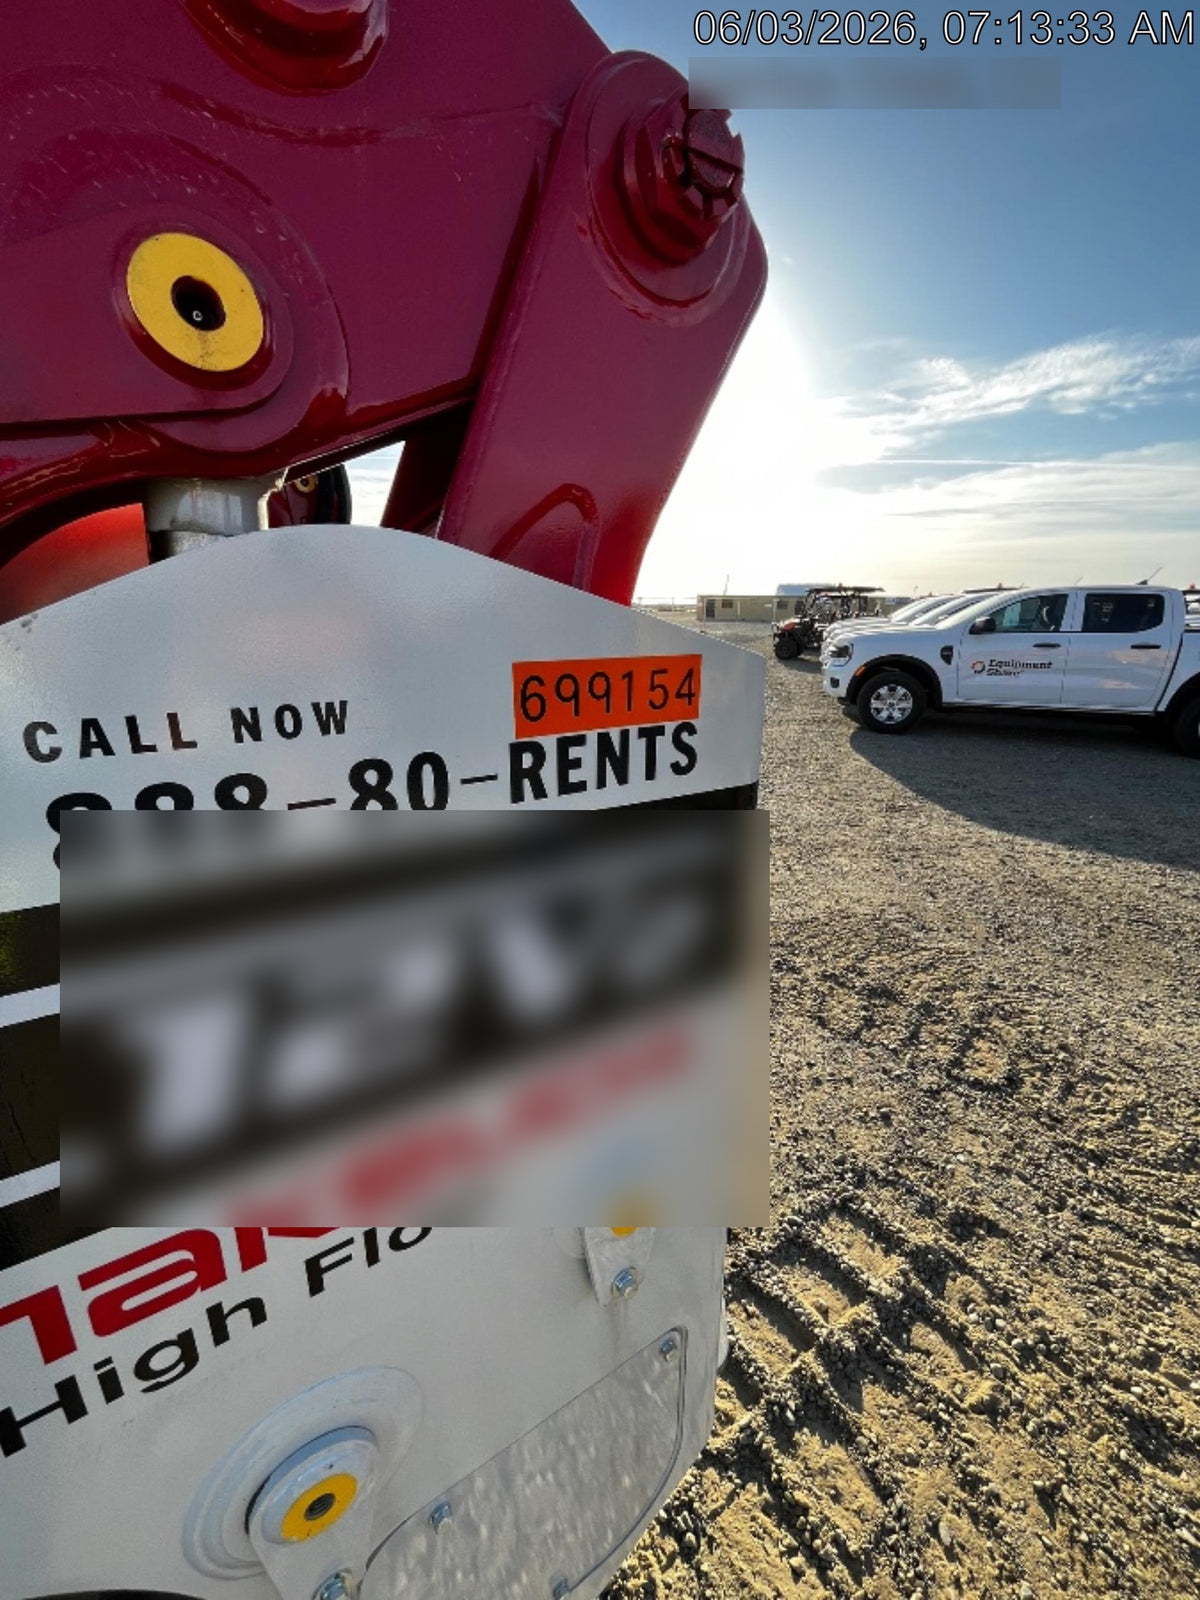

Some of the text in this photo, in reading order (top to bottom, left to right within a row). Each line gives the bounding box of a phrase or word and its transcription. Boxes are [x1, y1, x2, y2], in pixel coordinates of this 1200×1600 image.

[23, 700, 347, 763] CALL NOW
[520, 668, 697, 723] 699154
[46, 722, 698, 864] -80-RENTS
[0, 1297, 267, 1457] High
